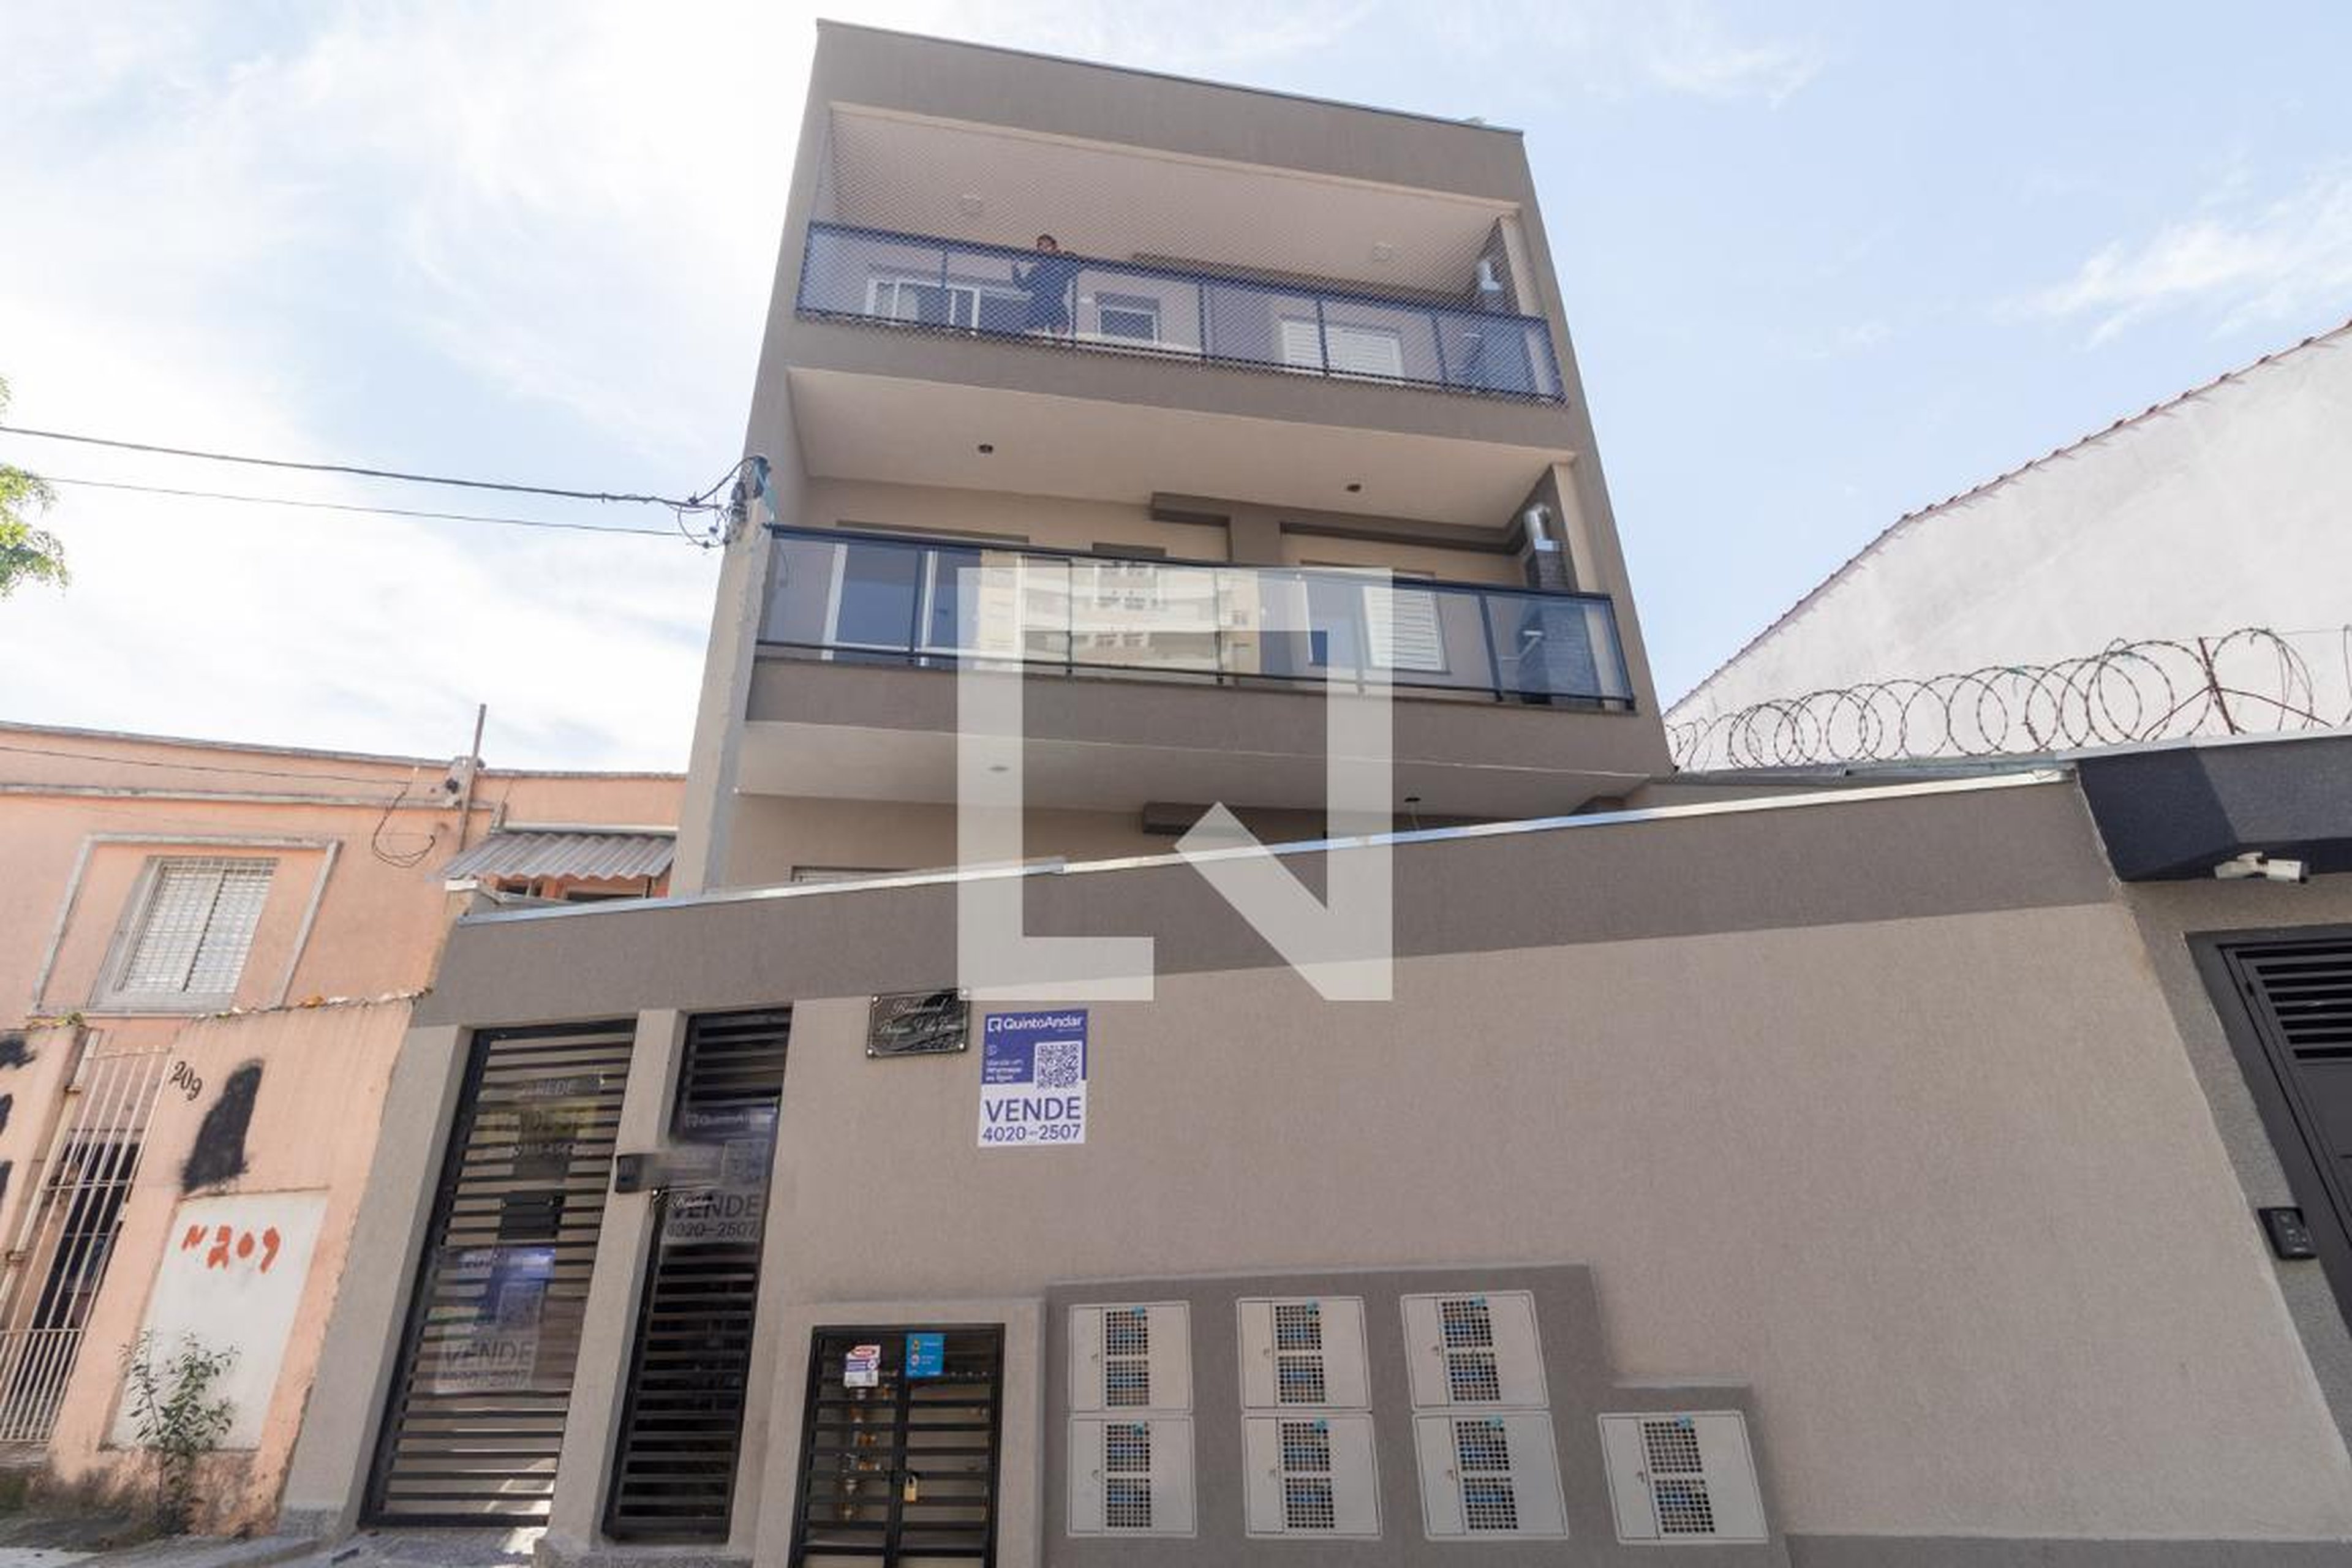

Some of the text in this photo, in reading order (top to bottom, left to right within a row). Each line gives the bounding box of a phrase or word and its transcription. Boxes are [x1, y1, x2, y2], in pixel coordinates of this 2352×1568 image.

[1003, 1015, 1084, 1030] QuintoAndar
[169, 1061, 203, 1101] 209
[985, 1096, 1081, 1123] VENDE
[982, 1124, 1081, 1142] 4020-2507
